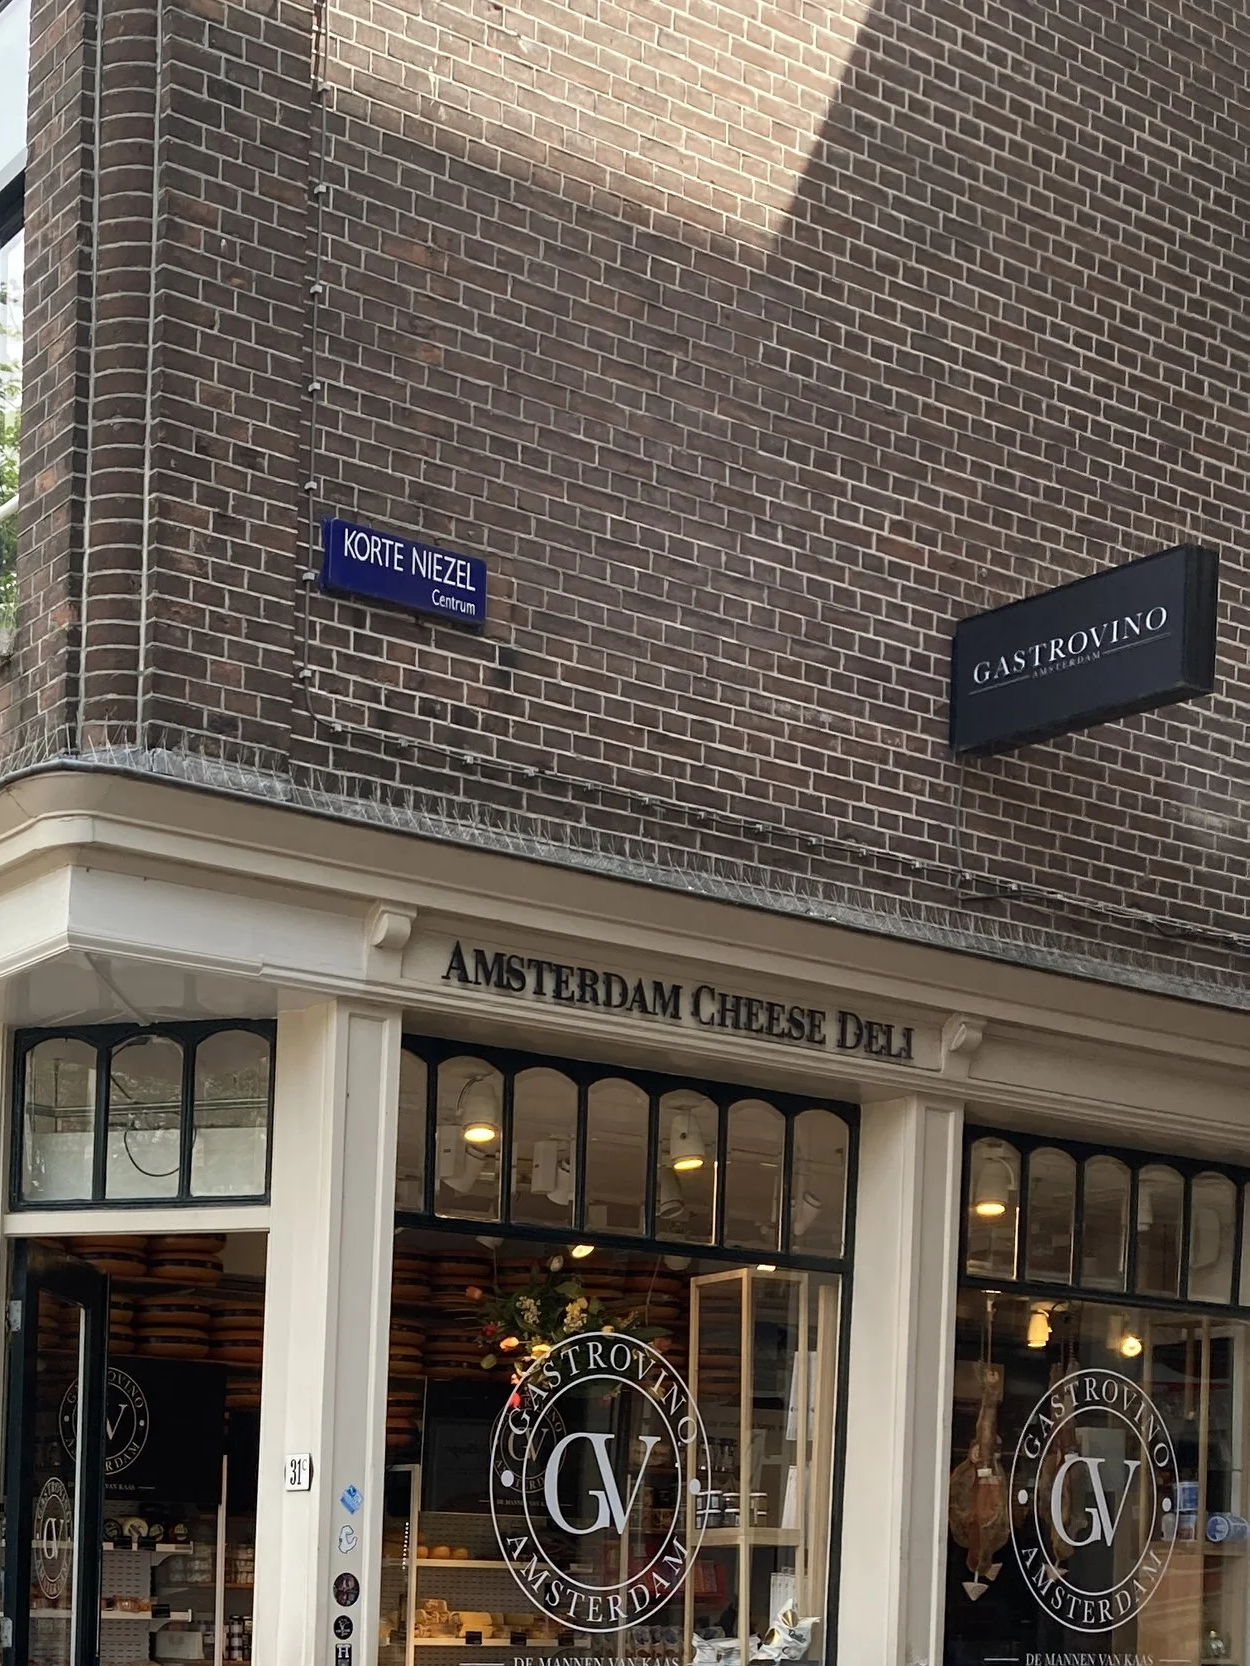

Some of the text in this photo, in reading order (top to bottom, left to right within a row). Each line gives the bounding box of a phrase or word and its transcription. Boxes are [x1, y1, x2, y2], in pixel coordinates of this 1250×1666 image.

[344, 528, 476, 592] KORTE NIEZEL
[432, 589, 476, 616] Centrum
[973, 606, 1168, 685] GASTROVINO
[1032, 650, 1101, 680] AMSTERDAM
[441, 939, 915, 1060] AMSTERDAM CHEESE DELI
[508, 1341, 698, 1444] GASTROVINO
[1023, 1377, 1170, 1468] GASTROVINO
[544, 1432, 662, 1535] GV
[1051, 1456, 1141, 1547] GV
[506, 1535, 690, 1623] AMSTERDAM
[1021, 1547, 1162, 1624] AMSTERDAM
[1025, 1653, 1154, 1666] DE MANNEN VAN KAAS
